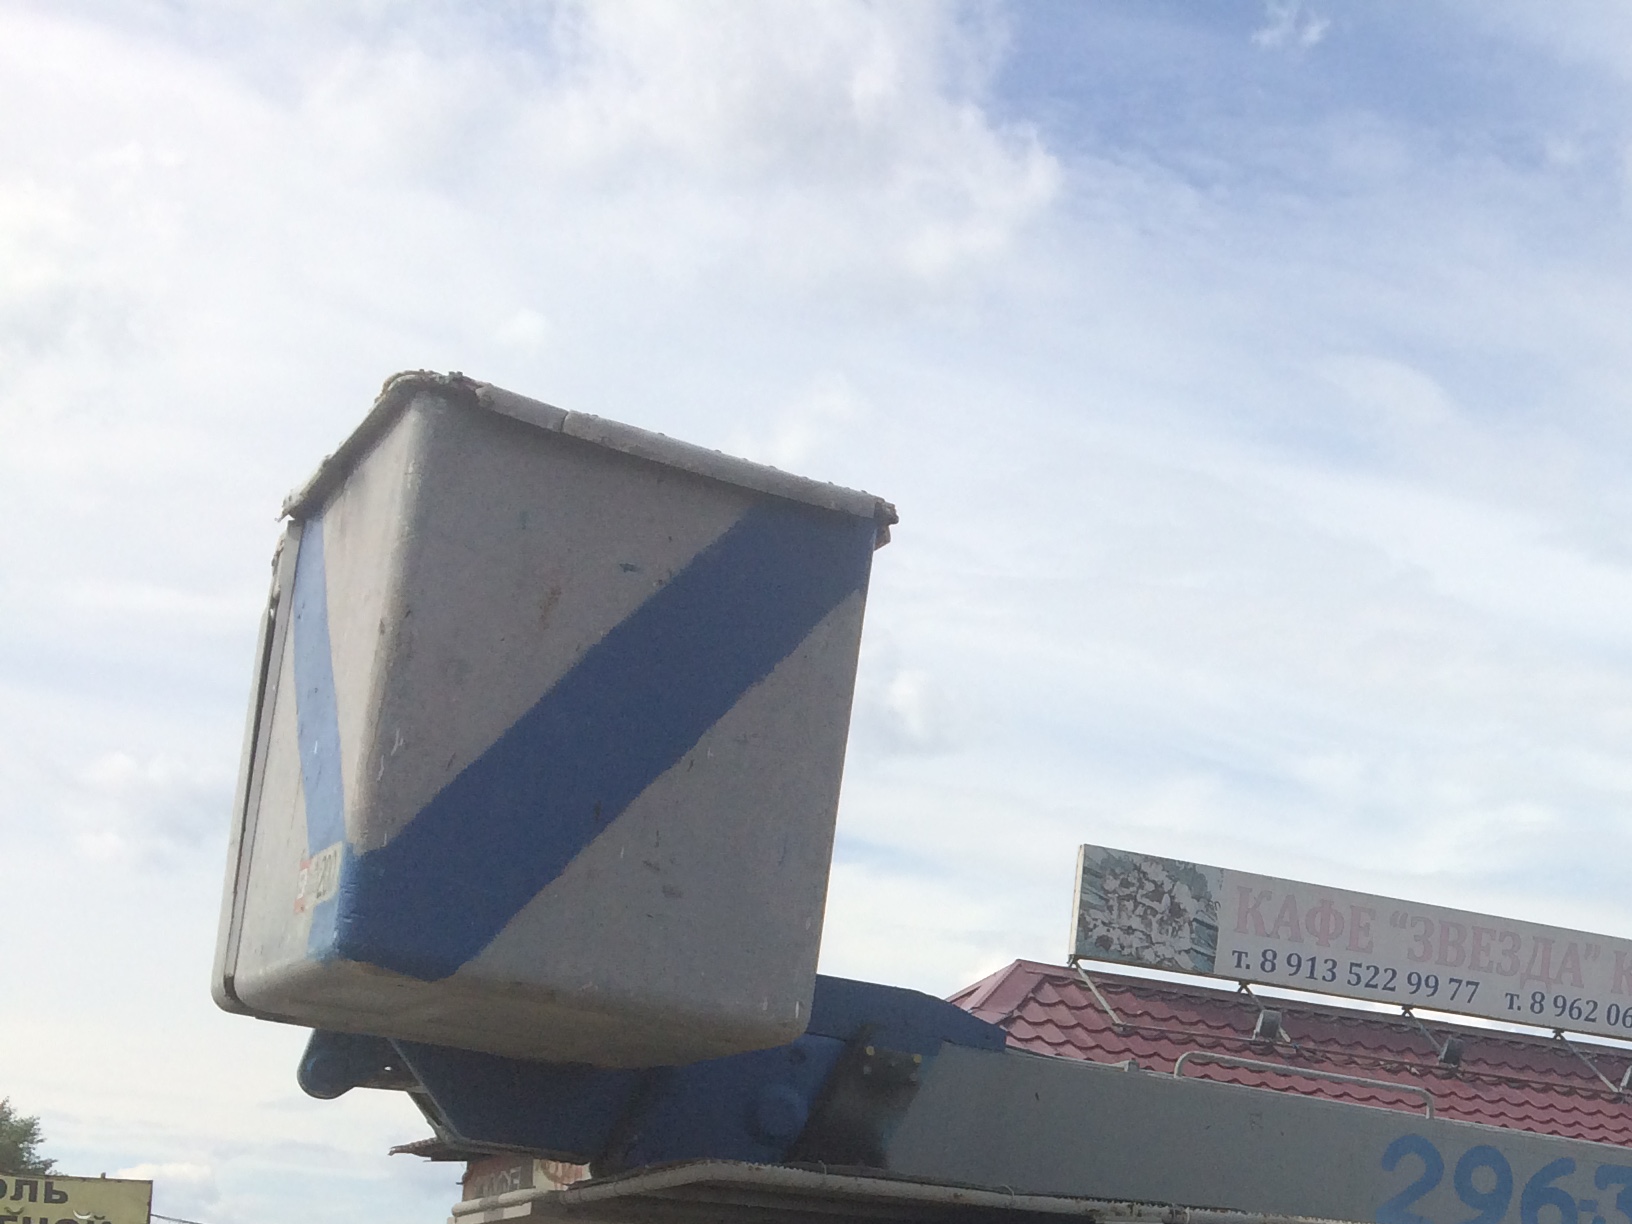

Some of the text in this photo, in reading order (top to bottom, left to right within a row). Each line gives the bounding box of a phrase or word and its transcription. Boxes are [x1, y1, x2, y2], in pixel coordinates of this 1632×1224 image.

[1233, 885, 1377, 954] КАФЕ
[1260, 948, 1278, 974] 8
[1286, 952, 1338, 983] 913
[1347, 962, 1398, 992] 522
[1407, 970, 1440, 998] 99
[1448, 977, 1481, 1005] 77
[1529, 990, 1546, 1015] 8
[1553, 994, 1598, 1023] 962
